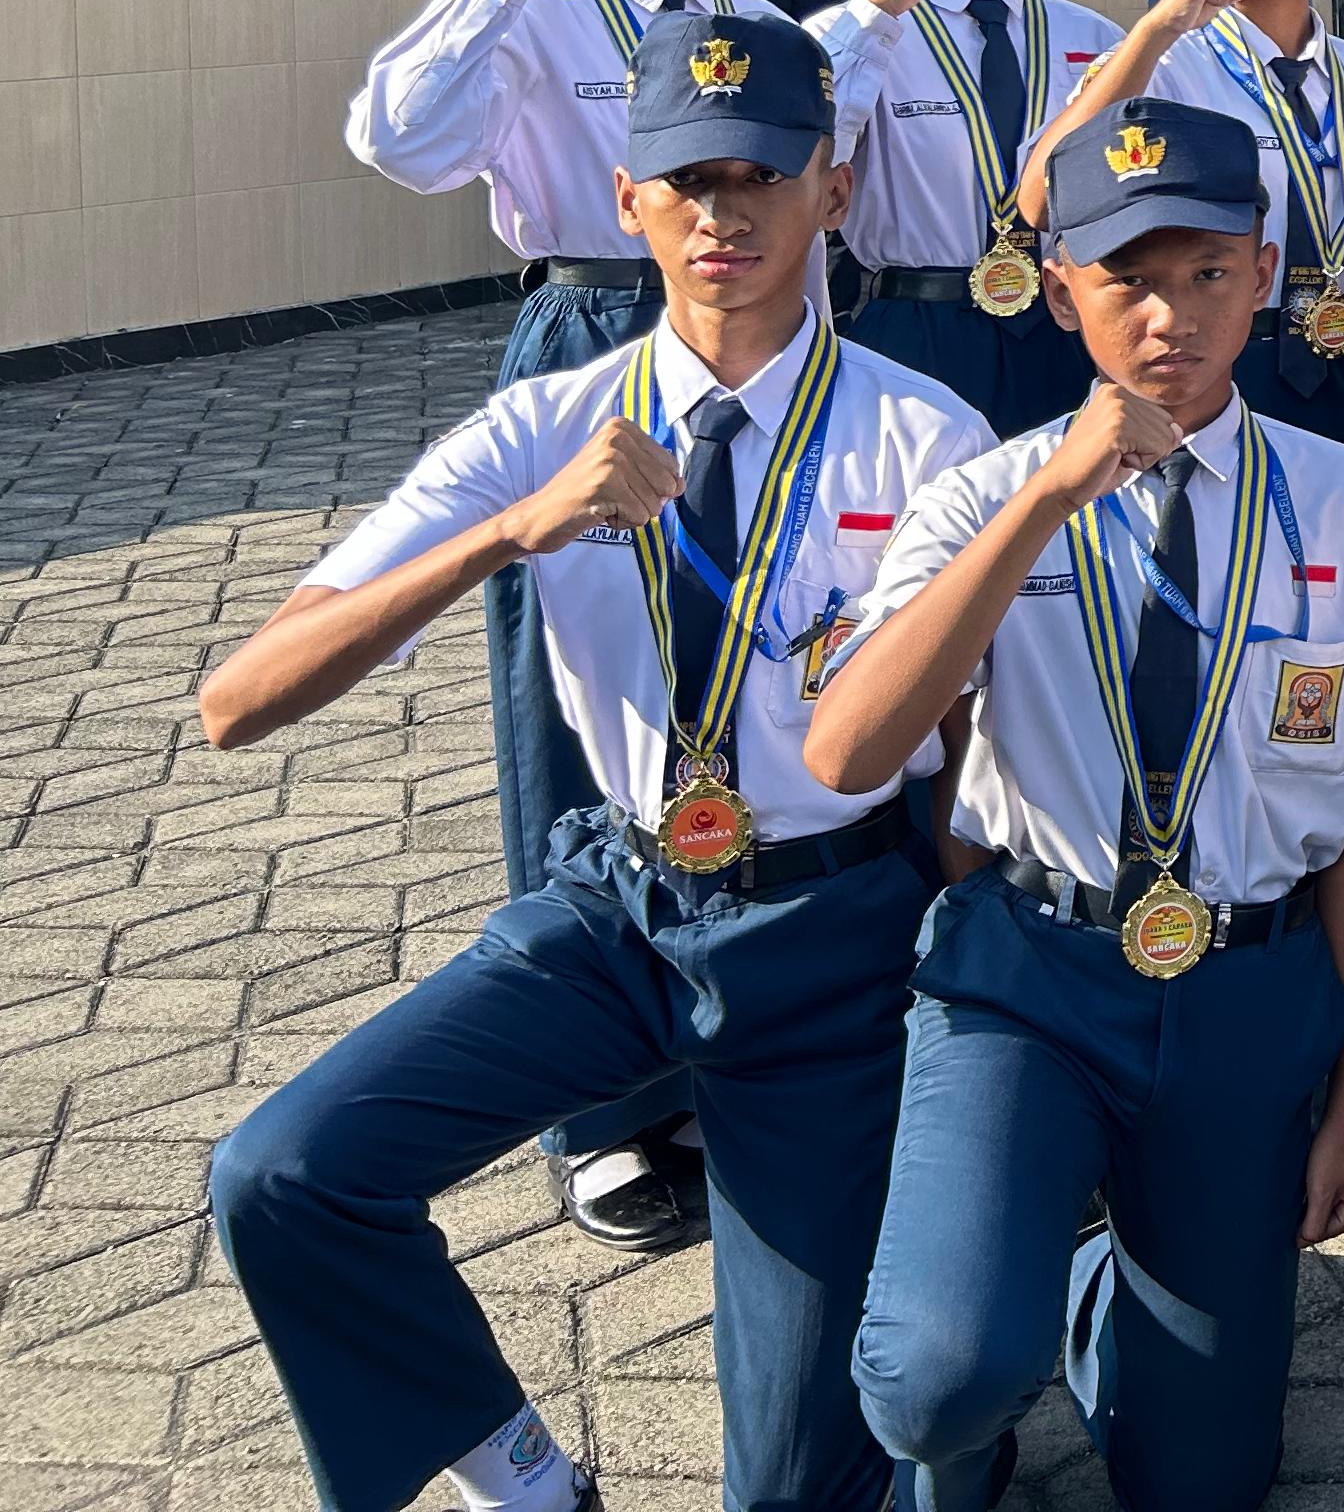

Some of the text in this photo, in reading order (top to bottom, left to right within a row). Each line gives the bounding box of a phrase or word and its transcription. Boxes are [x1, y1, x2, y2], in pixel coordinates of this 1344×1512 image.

[787, 532, 801, 565] HANG
[795, 504, 809, 530] TUAH
[1165, 582, 1185, 608] TUAH
[1287, 729, 1320, 738] OSIS
[679, 828, 733, 845] SANCAKA
